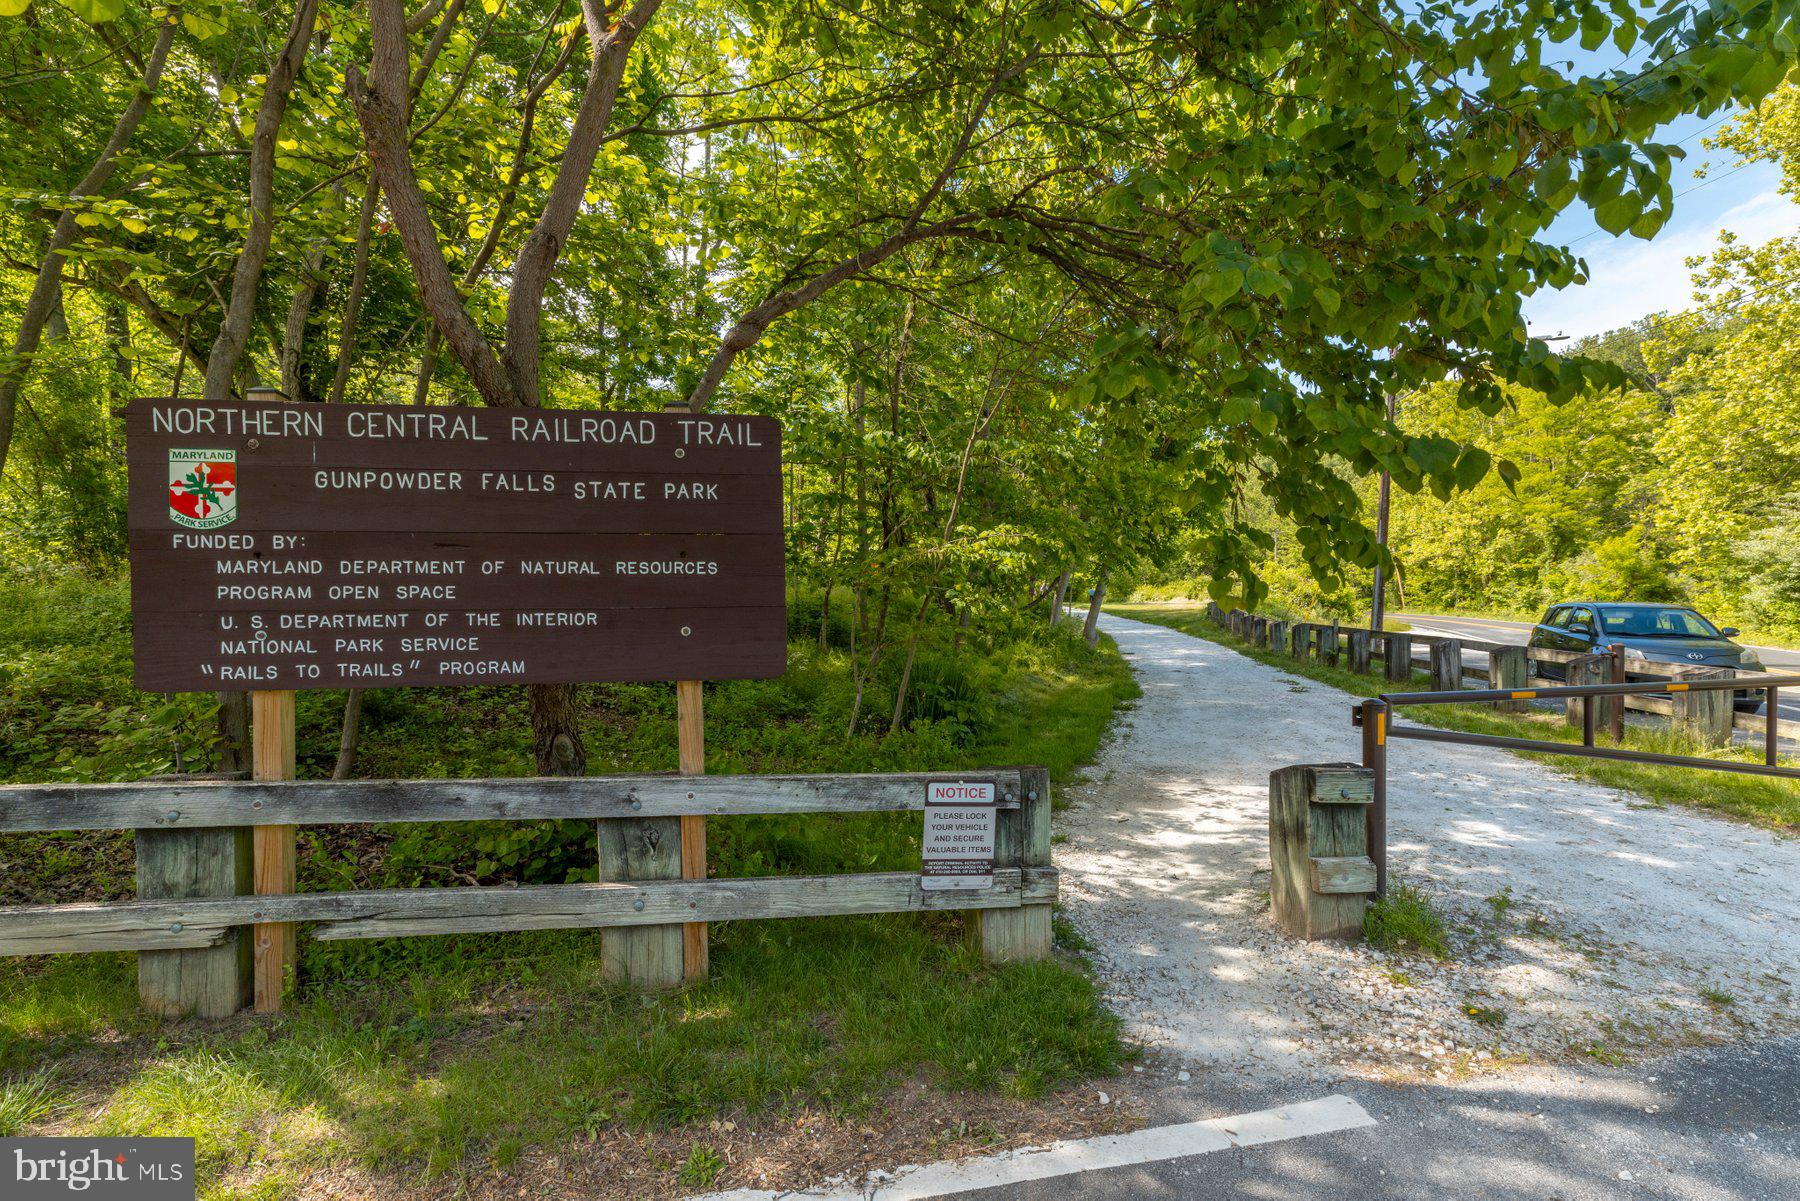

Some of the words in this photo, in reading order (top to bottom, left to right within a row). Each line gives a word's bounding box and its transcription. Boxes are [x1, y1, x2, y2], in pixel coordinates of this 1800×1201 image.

[152, 407, 323, 437] NORTHERN
[347, 412, 489, 441] CENTRAL
[511, 416, 656, 445] RAILROAD
[677, 420, 763, 447] TRAIL
[172, 451, 233, 460] MARYLAND
[314, 471, 464, 490] GUNPOWDER
[481, 473, 555, 491] FALLS
[574, 481, 646, 499] STATE
[664, 483, 718, 500] PARK
[173, 513, 196, 527] PARK
[197, 514, 233, 528] SERVICE
[172, 534, 255, 550] FUNDED
[272, 535, 306, 549] BY:
[216, 560, 323, 575] MARYLAND
[340, 560, 466, 575] DEPARTMENT
[481, 560, 504, 575] OF
[520, 560, 600, 575] NATURAL
[615, 560, 718, 575] RESOURCES
[217, 586, 312, 600] PROGRAM
[328, 585, 380, 600] OPEN
[396, 585, 456, 600] SPACE
[280, 614, 409, 629] DEPARTMENT
[424, 613, 449, 627] OF
[465, 613, 501, 627] THE
[516, 612, 598, 627] INTERIOR
[220, 640, 318, 655] NATIONAL
[335, 639, 384, 653] PARK
[400, 637, 480, 652] SERVICE
[295, 664, 321, 679] TO
[439, 660, 526, 676] PROGRAM
[935, 787, 987, 799] NOTICE
[933, 812, 964, 820] PLEASE
[965, 812, 987, 820] LOCK
[931, 823, 954, 831] YOUR
[955, 823, 989, 831] VEHICLE
[934, 834, 952, 842] AND
[952, 834, 985, 842] SECURE
